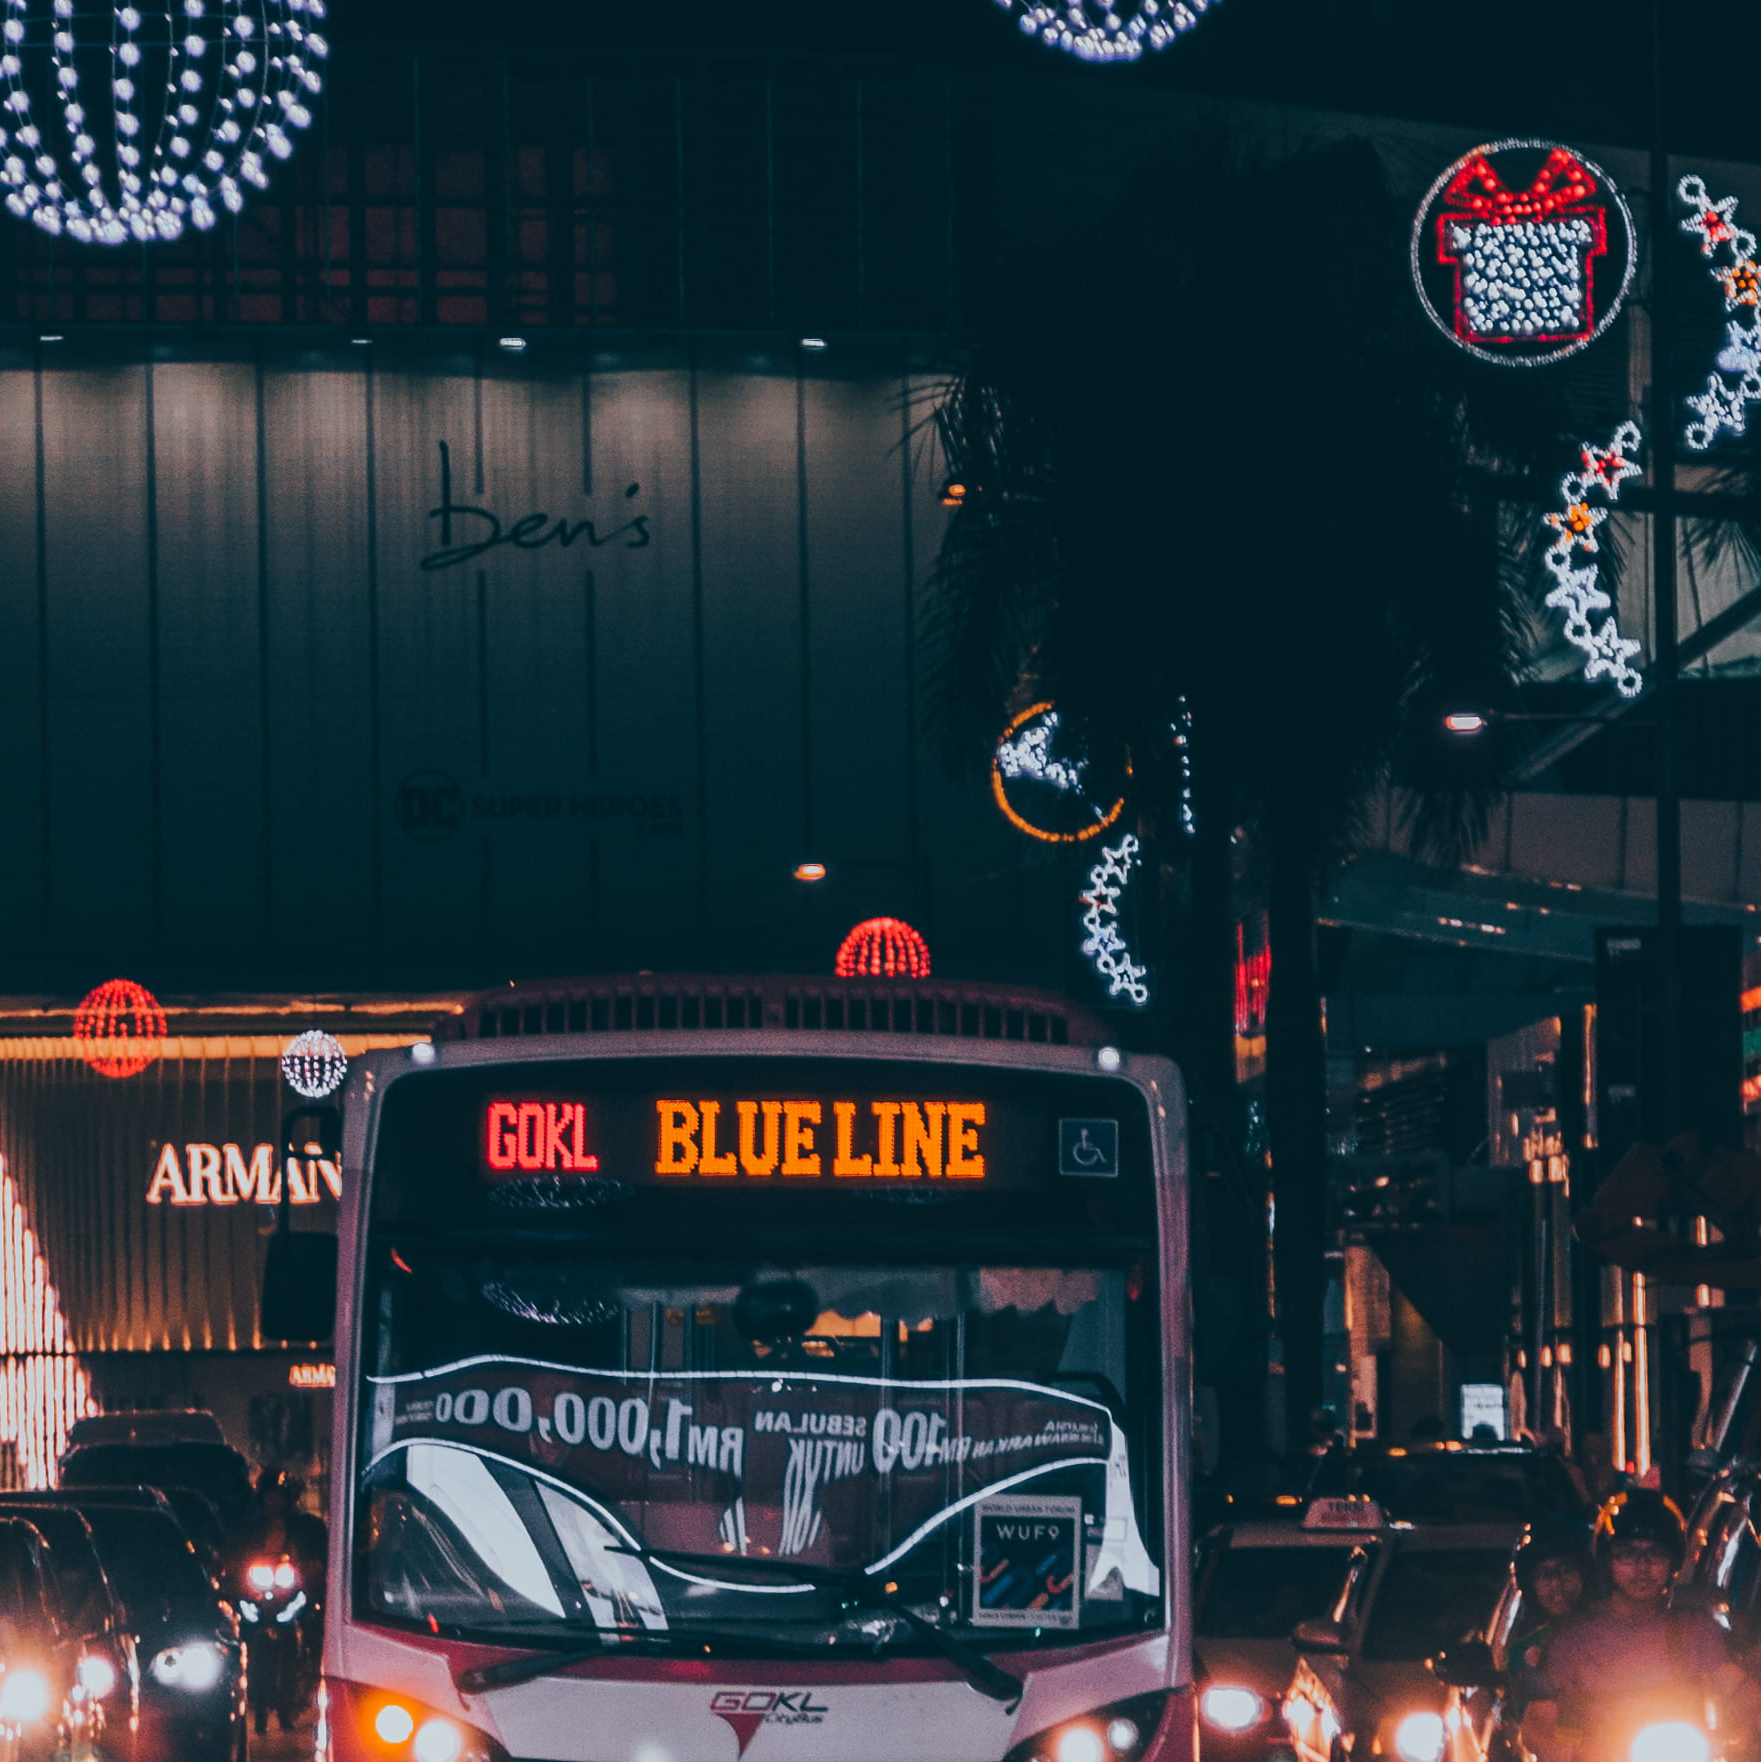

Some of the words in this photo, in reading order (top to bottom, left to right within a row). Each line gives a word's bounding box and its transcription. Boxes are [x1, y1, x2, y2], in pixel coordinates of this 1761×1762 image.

[397, 788, 463, 827] DC
[472, 794, 562, 818] SUPER
[487, 1100, 599, 1172] GOKL
[655, 1099, 822, 1177] BLUE
[833, 1100, 986, 1178] LINE
[995, 1523, 1061, 1542] WUF9
[709, 1691, 829, 1712] GOKL
